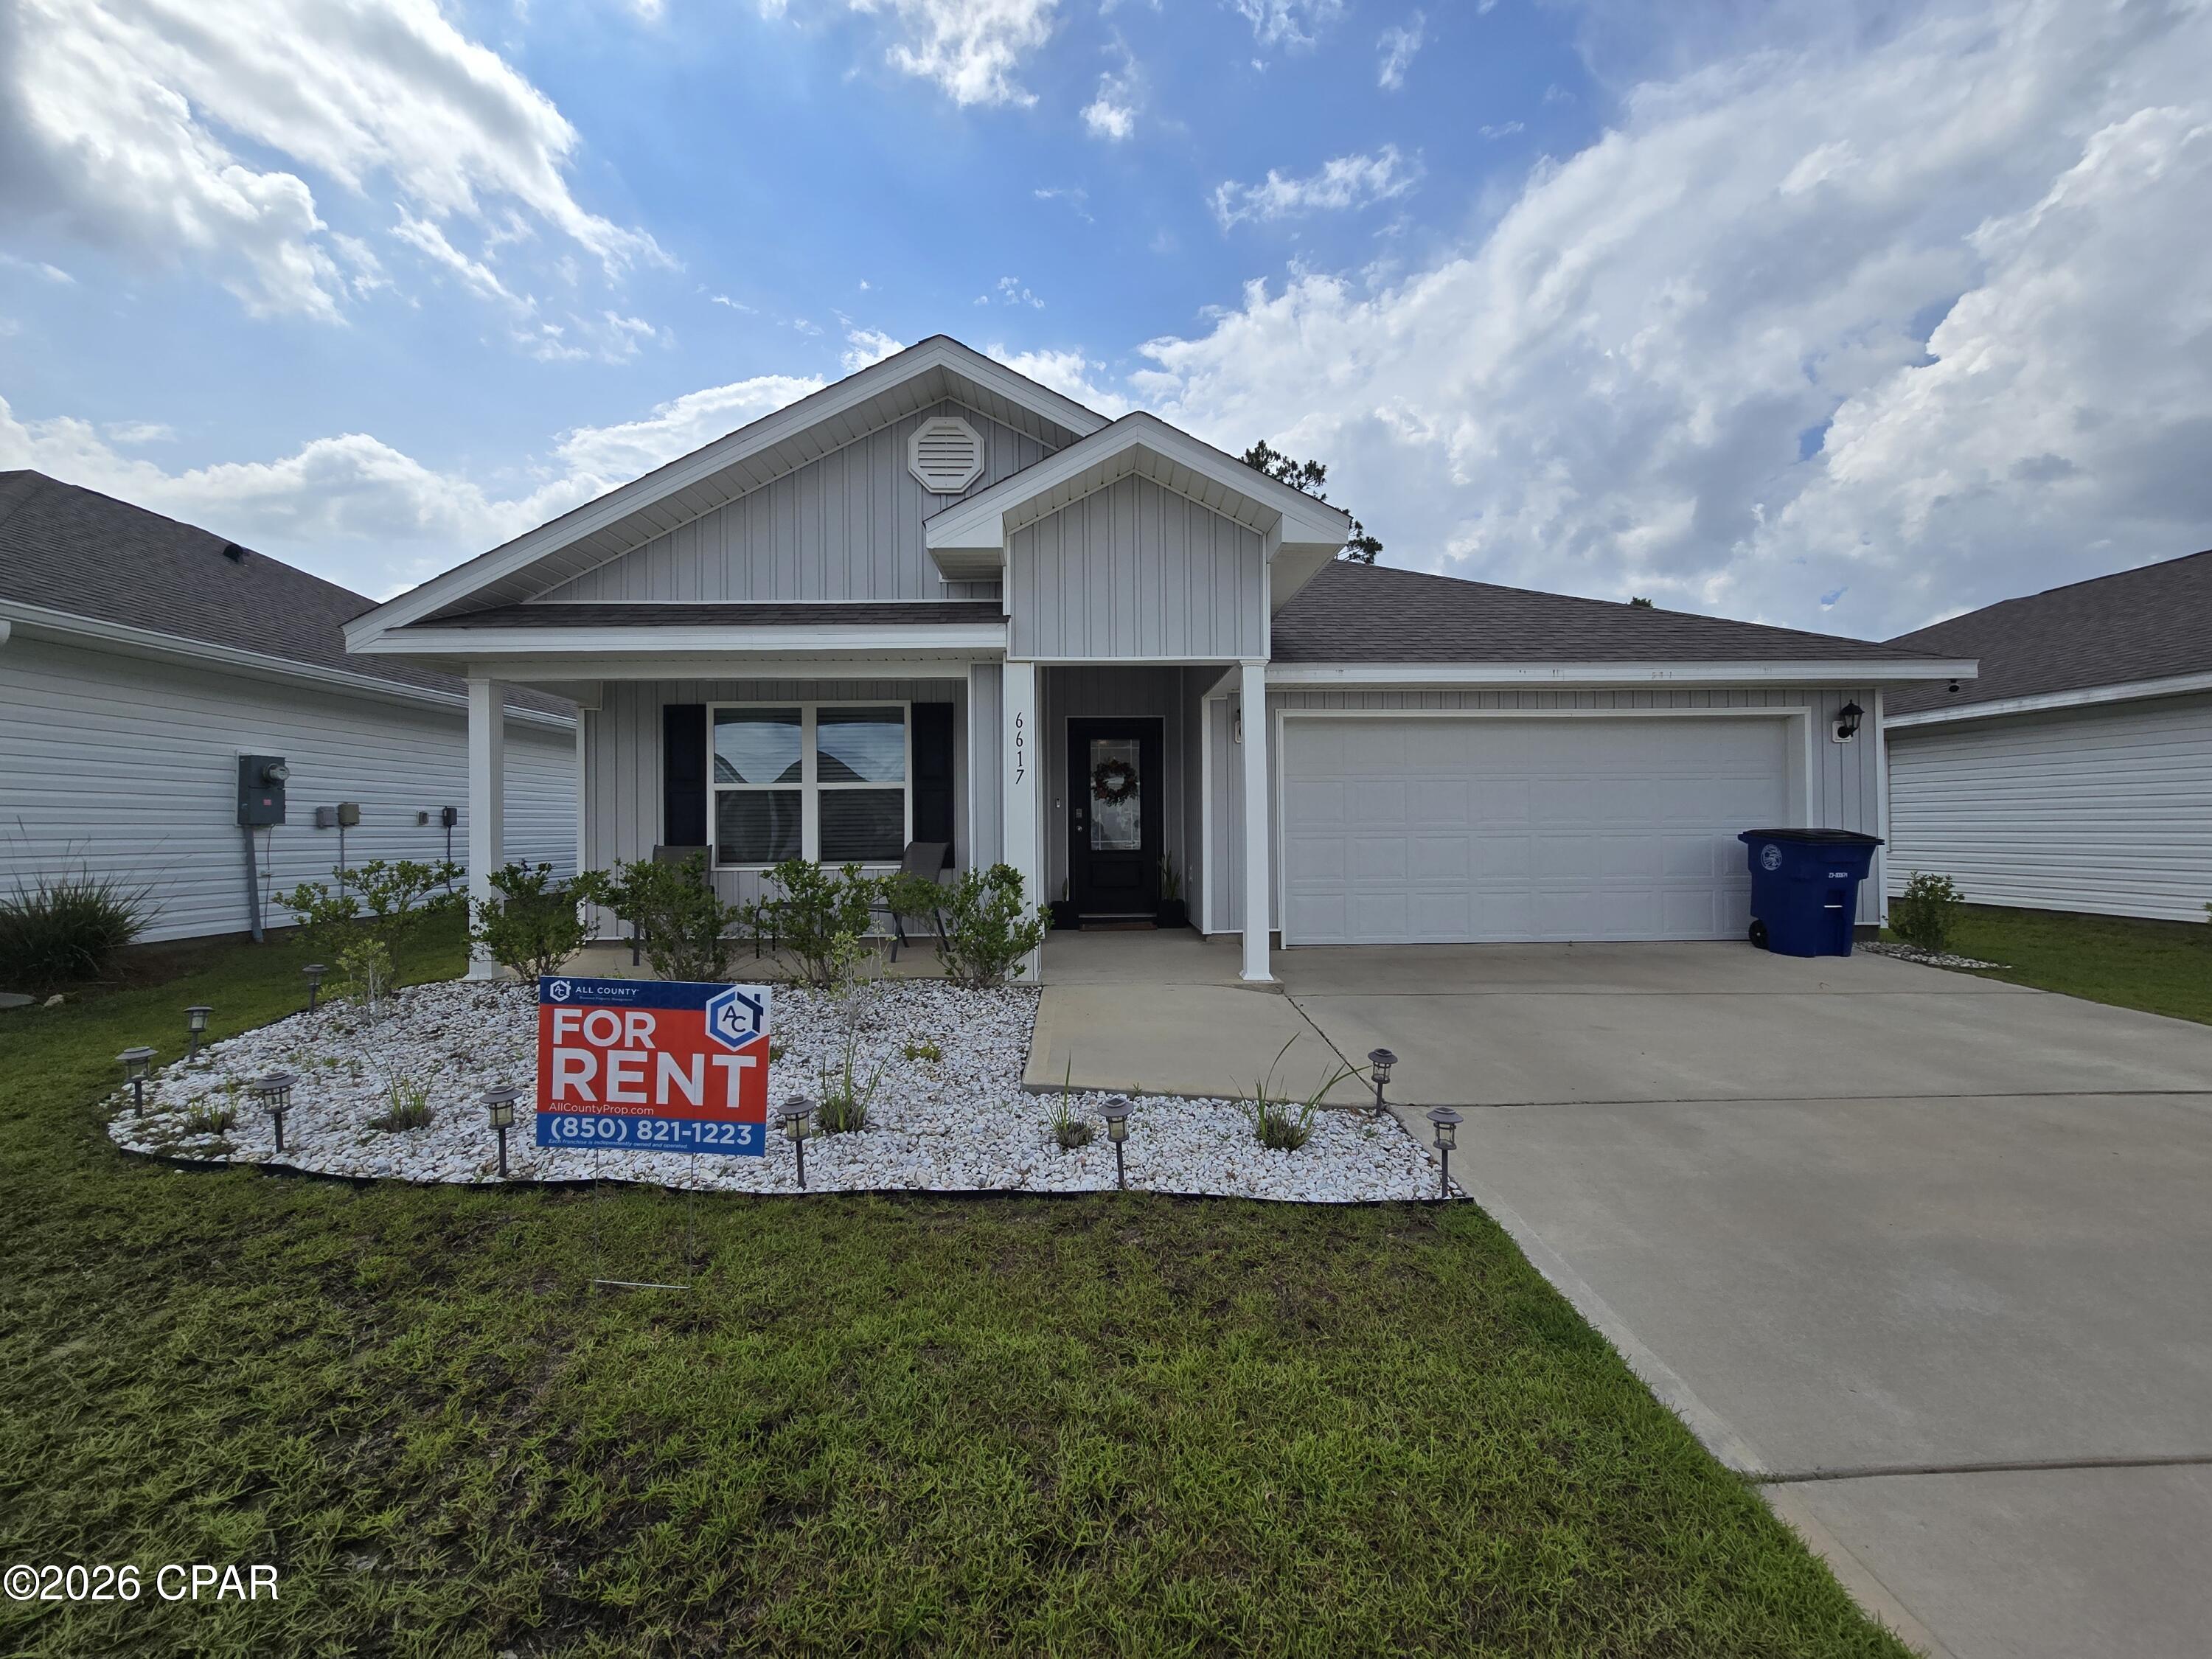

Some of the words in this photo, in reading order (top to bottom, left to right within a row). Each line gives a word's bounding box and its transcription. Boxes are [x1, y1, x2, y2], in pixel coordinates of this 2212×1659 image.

[1016, 712, 1024, 785] 6617
[597, 987, 637, 995] COUNTY
[553, 1008, 656, 1048] FOR
[722, 1005, 746, 1033] AC
[552, 1047, 757, 1108] RENT
[549, 1102, 654, 1116] AllCountyProp.com
[551, 1116, 627, 1142] (850)
[636, 1119, 752, 1145] 821-1223
